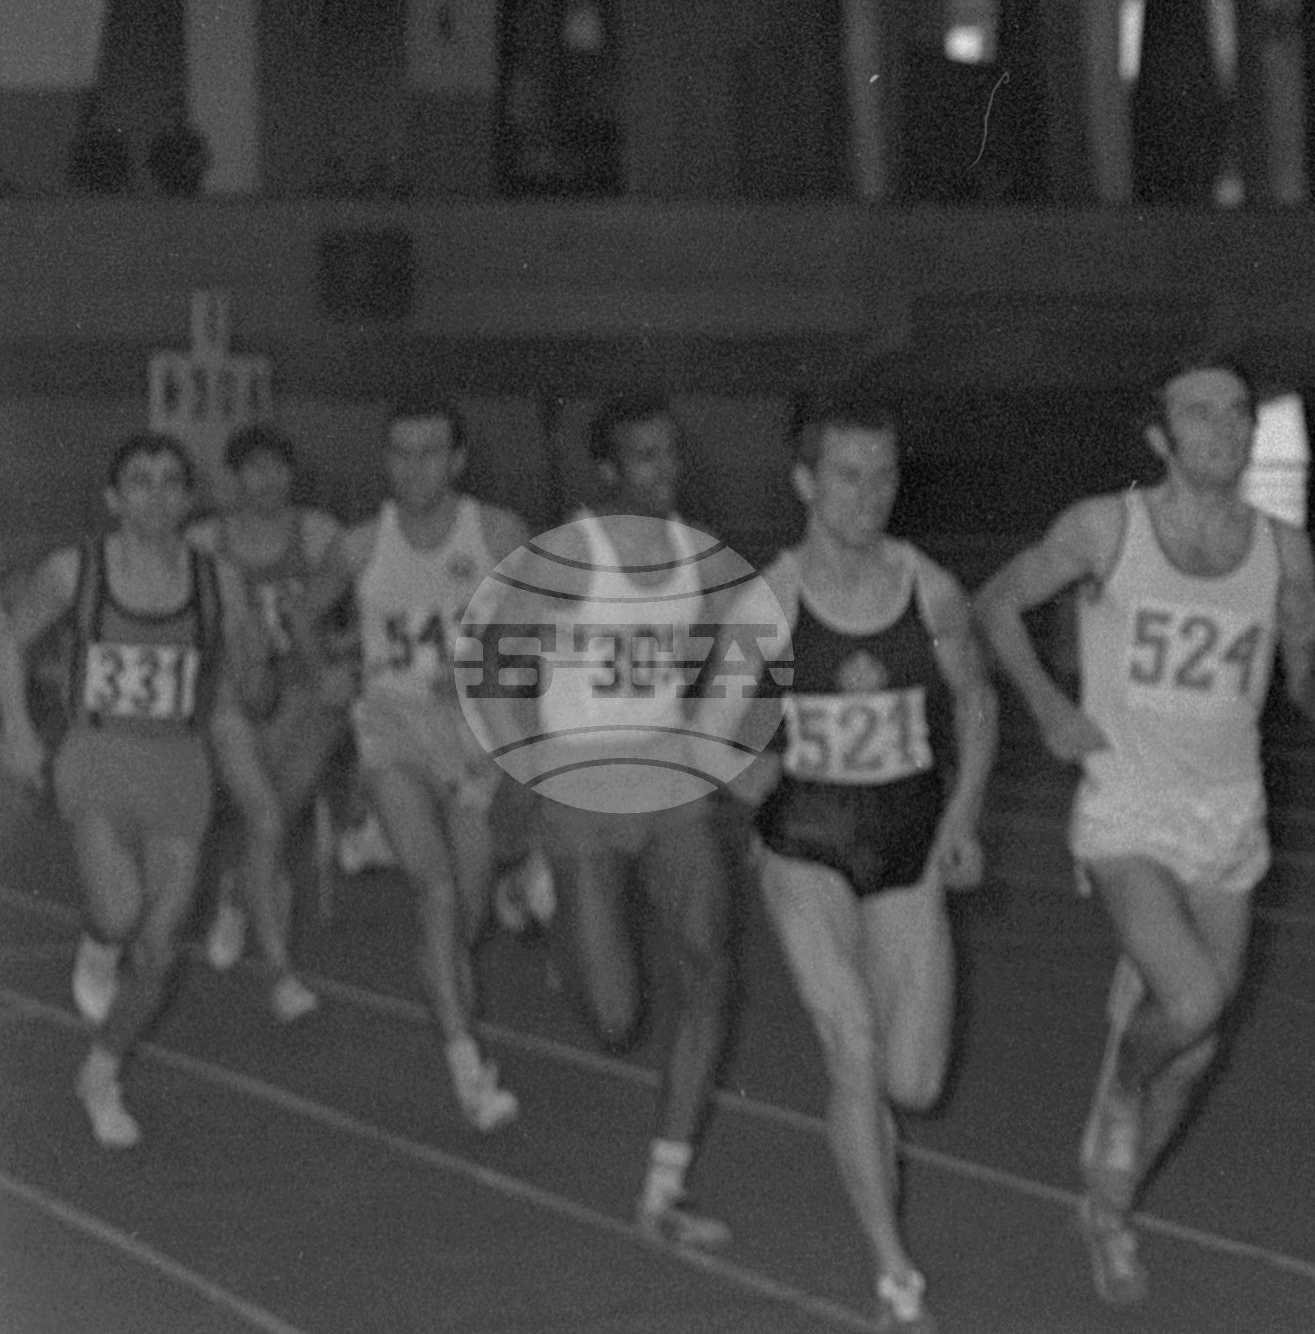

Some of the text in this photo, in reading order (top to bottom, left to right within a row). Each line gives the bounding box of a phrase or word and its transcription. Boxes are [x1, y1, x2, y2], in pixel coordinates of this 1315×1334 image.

[97, 647, 186, 711] 331
[1128, 610, 1264, 695] 524
[797, 698, 919, 773] 521
